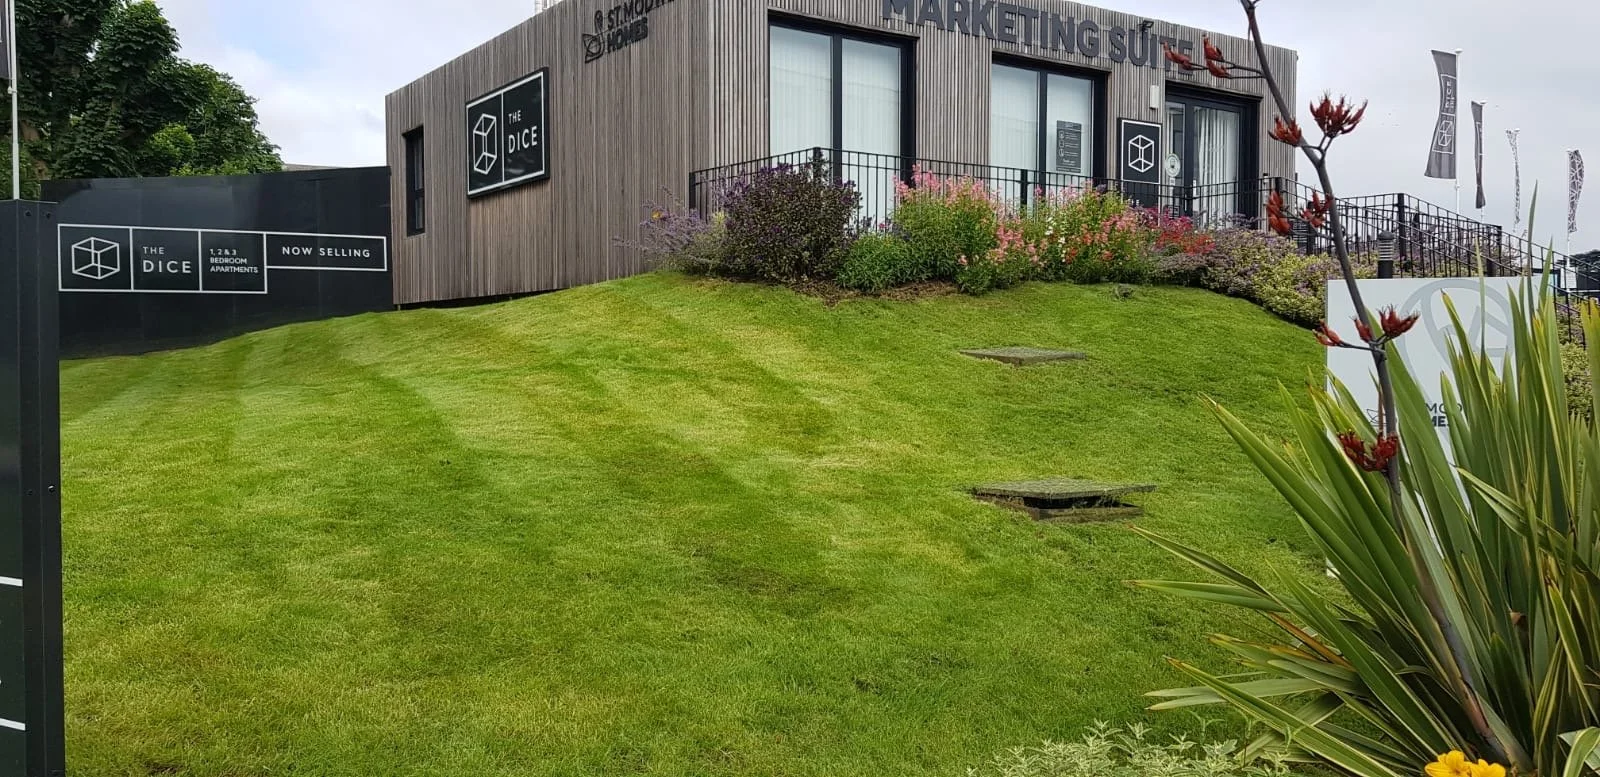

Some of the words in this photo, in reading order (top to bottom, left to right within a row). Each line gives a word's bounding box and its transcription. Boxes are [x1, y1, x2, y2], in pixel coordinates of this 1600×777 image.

[606, 16, 648, 54] HOMES
[882, 0, 1101, 58] MARKETING
[1108, 26, 1194, 76] SUITE
[508, 109, 522, 125] THE
[508, 125, 538, 154] DICE
[142, 246, 165, 255] THE
[217, 248, 222, 256] 2
[282, 246, 313, 256] NOW
[319, 247, 370, 258] SELLING
[142, 259, 192, 274] DICE
[210, 265, 259, 273] APARTMENTS
